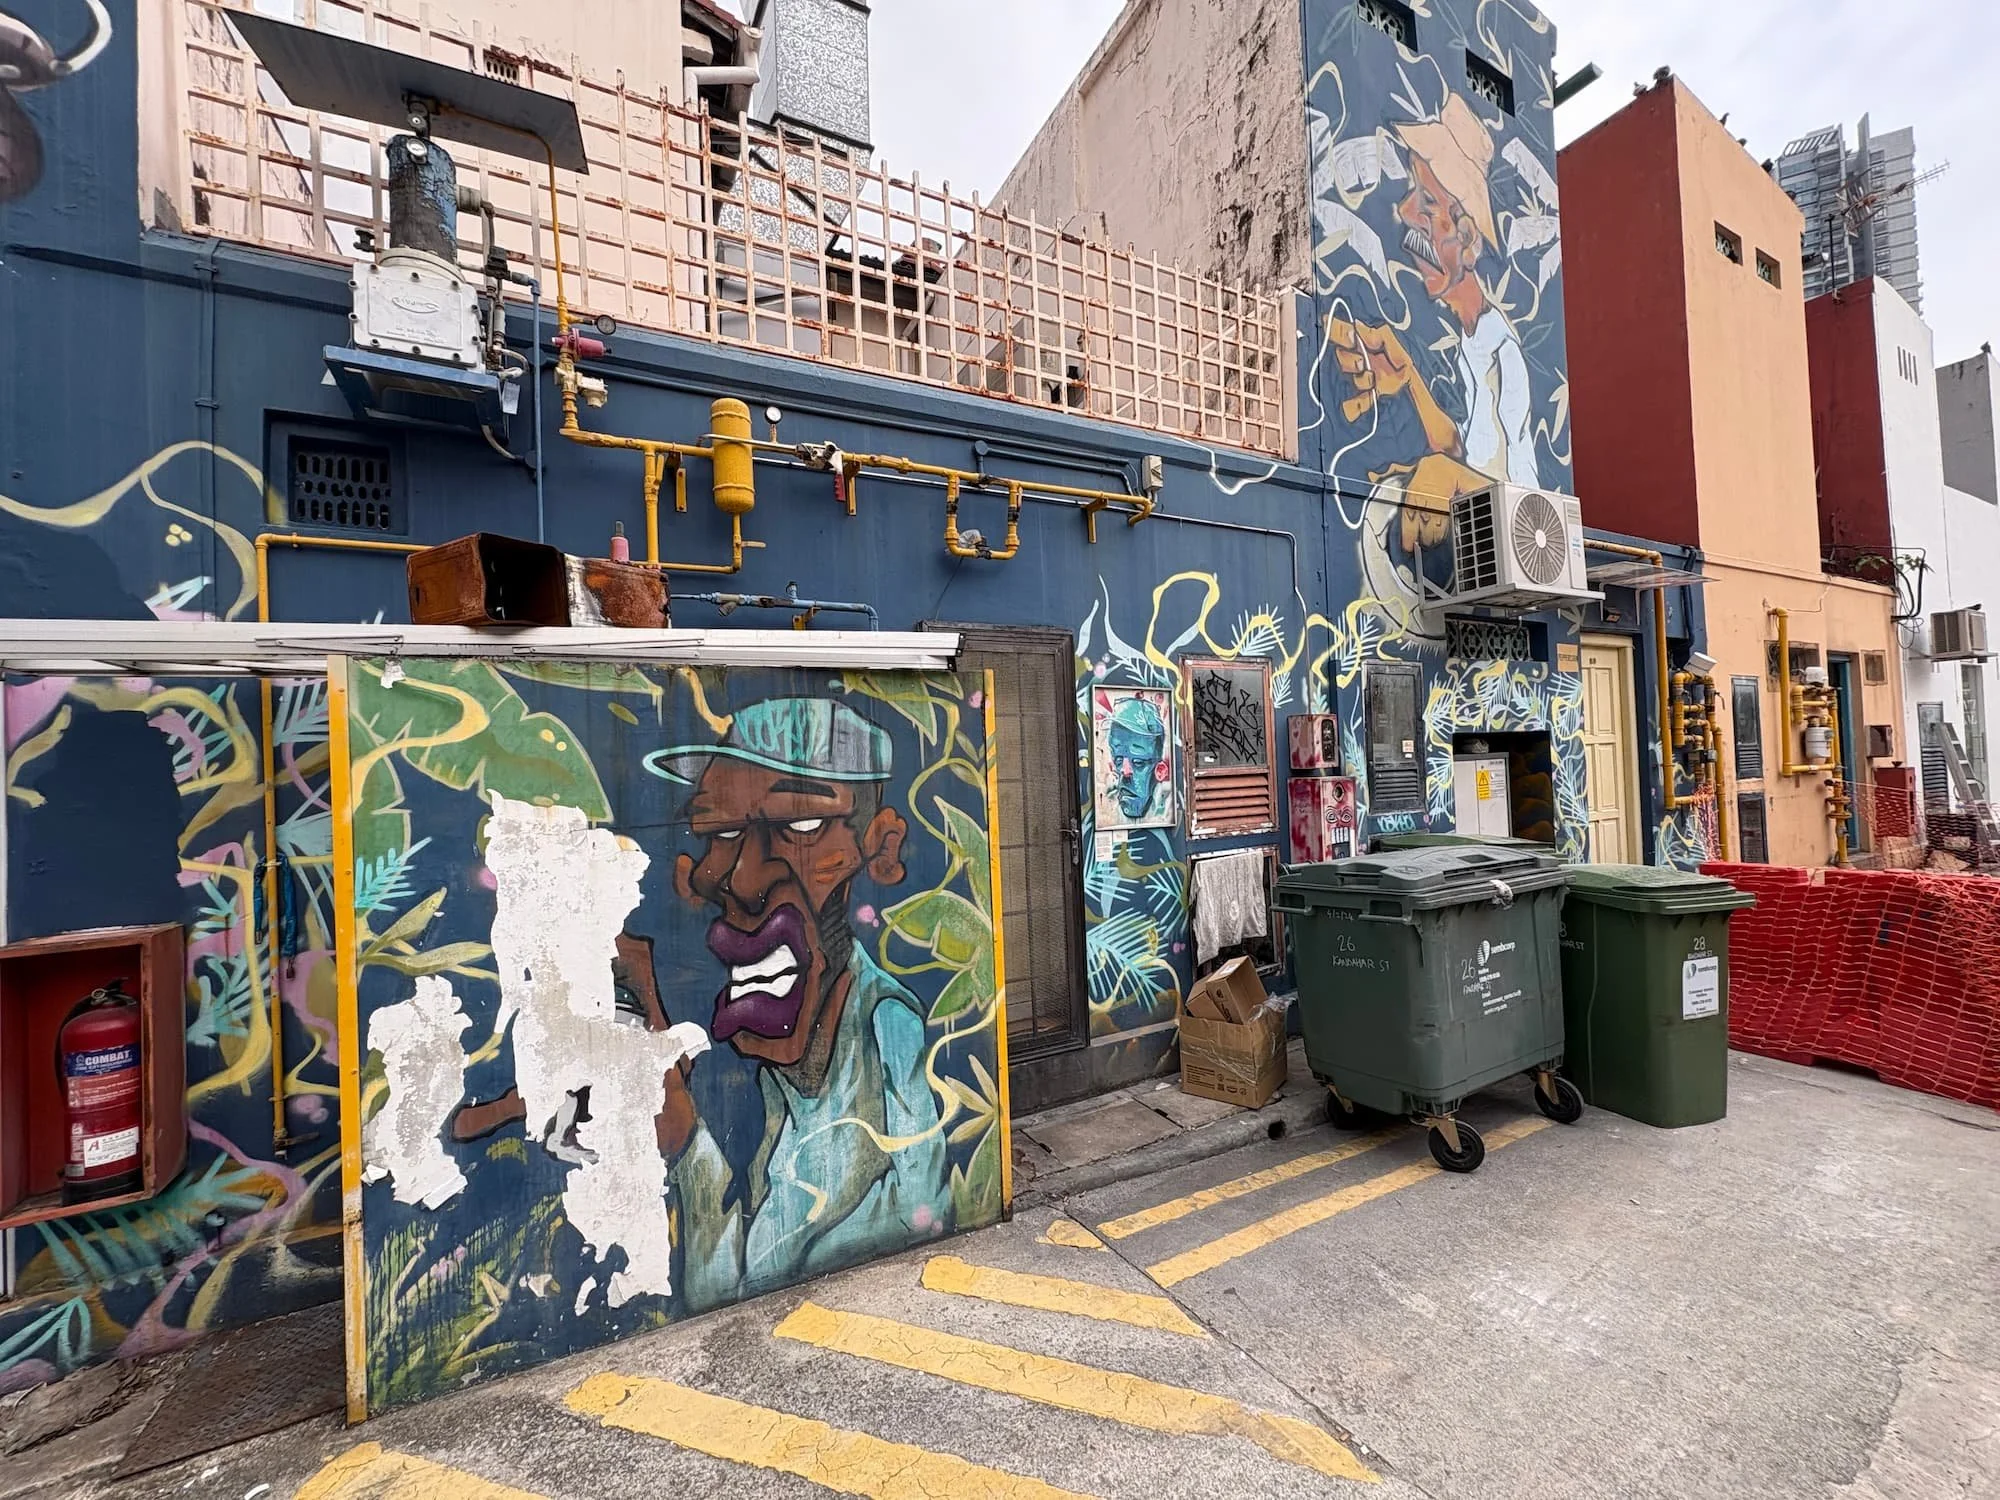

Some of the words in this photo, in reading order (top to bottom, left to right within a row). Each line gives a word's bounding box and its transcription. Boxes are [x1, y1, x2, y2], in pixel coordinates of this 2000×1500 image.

[1336, 934, 1356, 952] 26
[1694, 936, 1706, 951] 28
[1379, 959, 1390, 972] ST
[1461, 958, 1476, 981] 26
[85, 1050, 131, 1066] COMBAT
